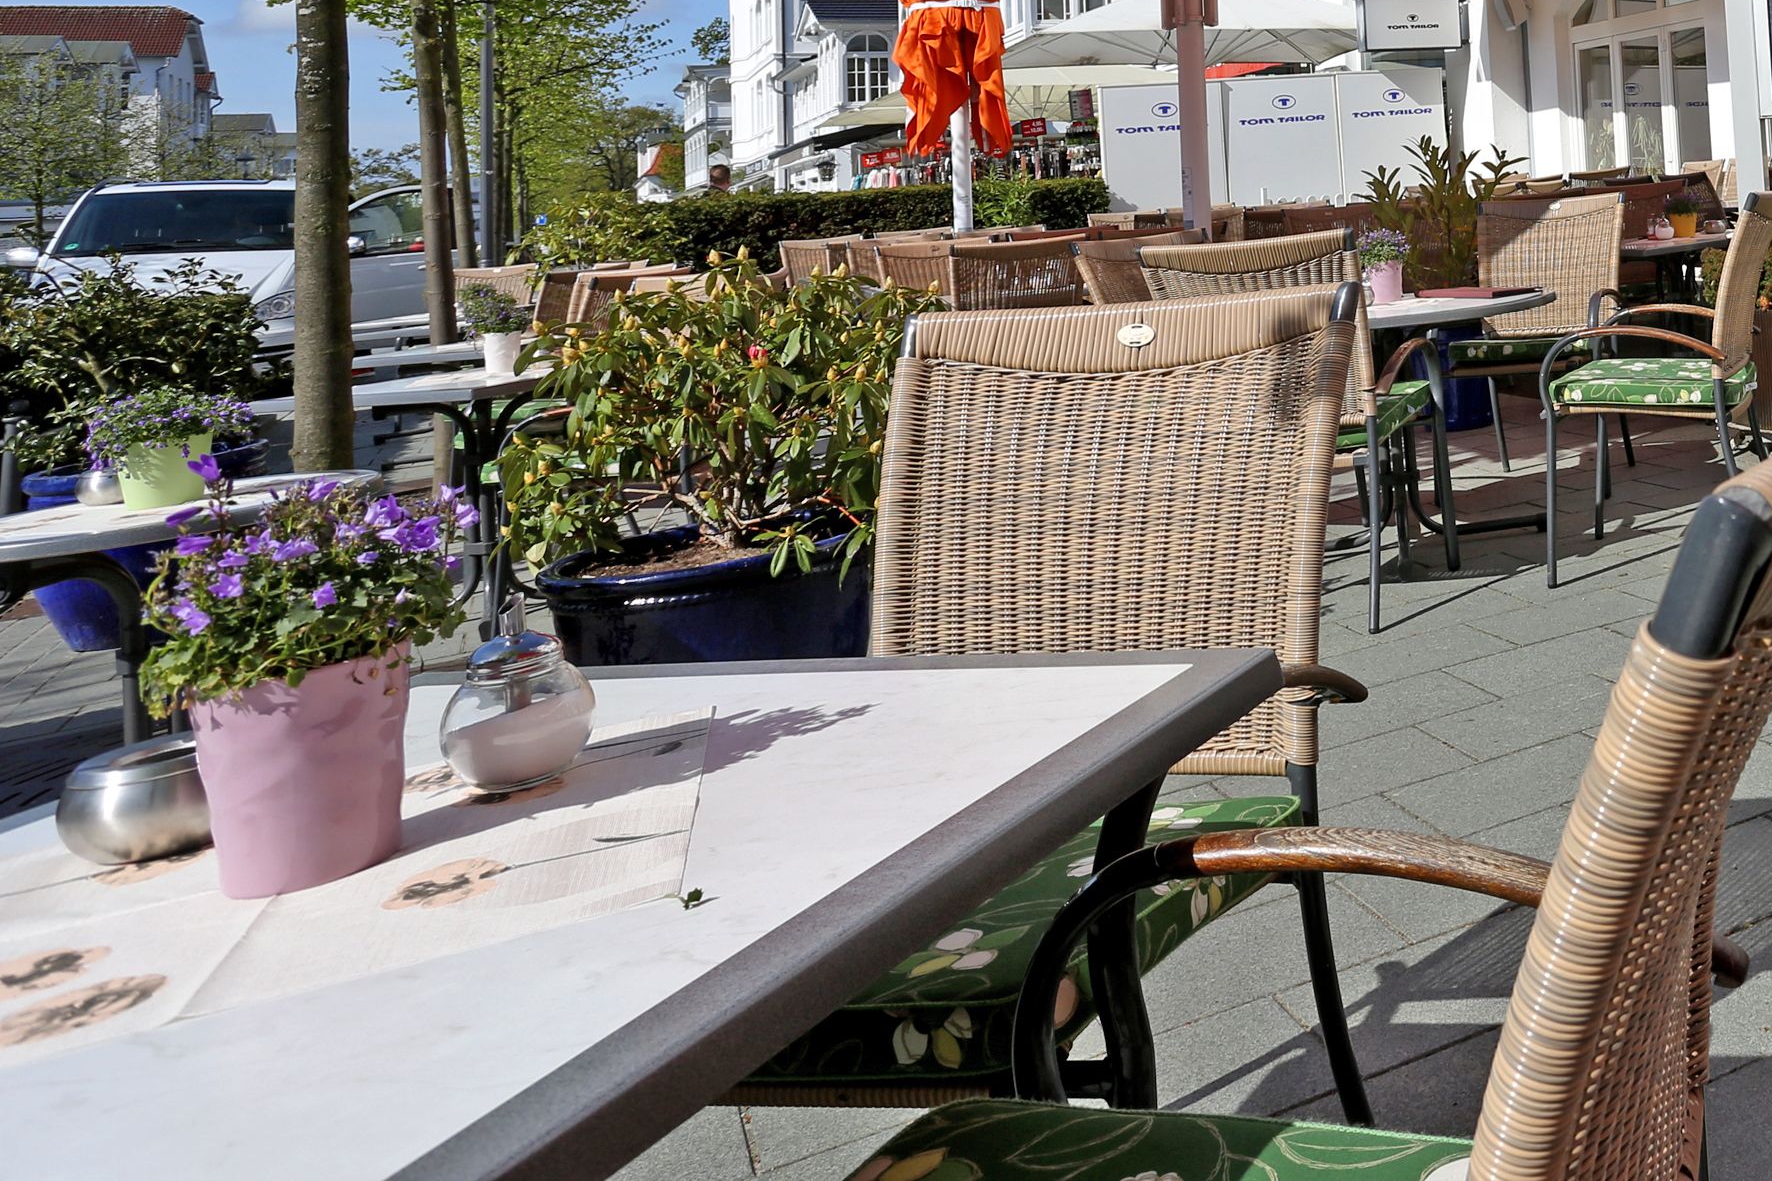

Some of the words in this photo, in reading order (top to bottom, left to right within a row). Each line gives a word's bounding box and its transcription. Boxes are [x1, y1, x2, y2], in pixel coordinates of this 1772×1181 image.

[1351, 110, 1386, 119] TOM
[1387, 107, 1433, 116] TAILOR
[1239, 118, 1275, 126] TOM
[1277, 114, 1326, 123] TAILOR
[1115, 126, 1154, 134] TOM
